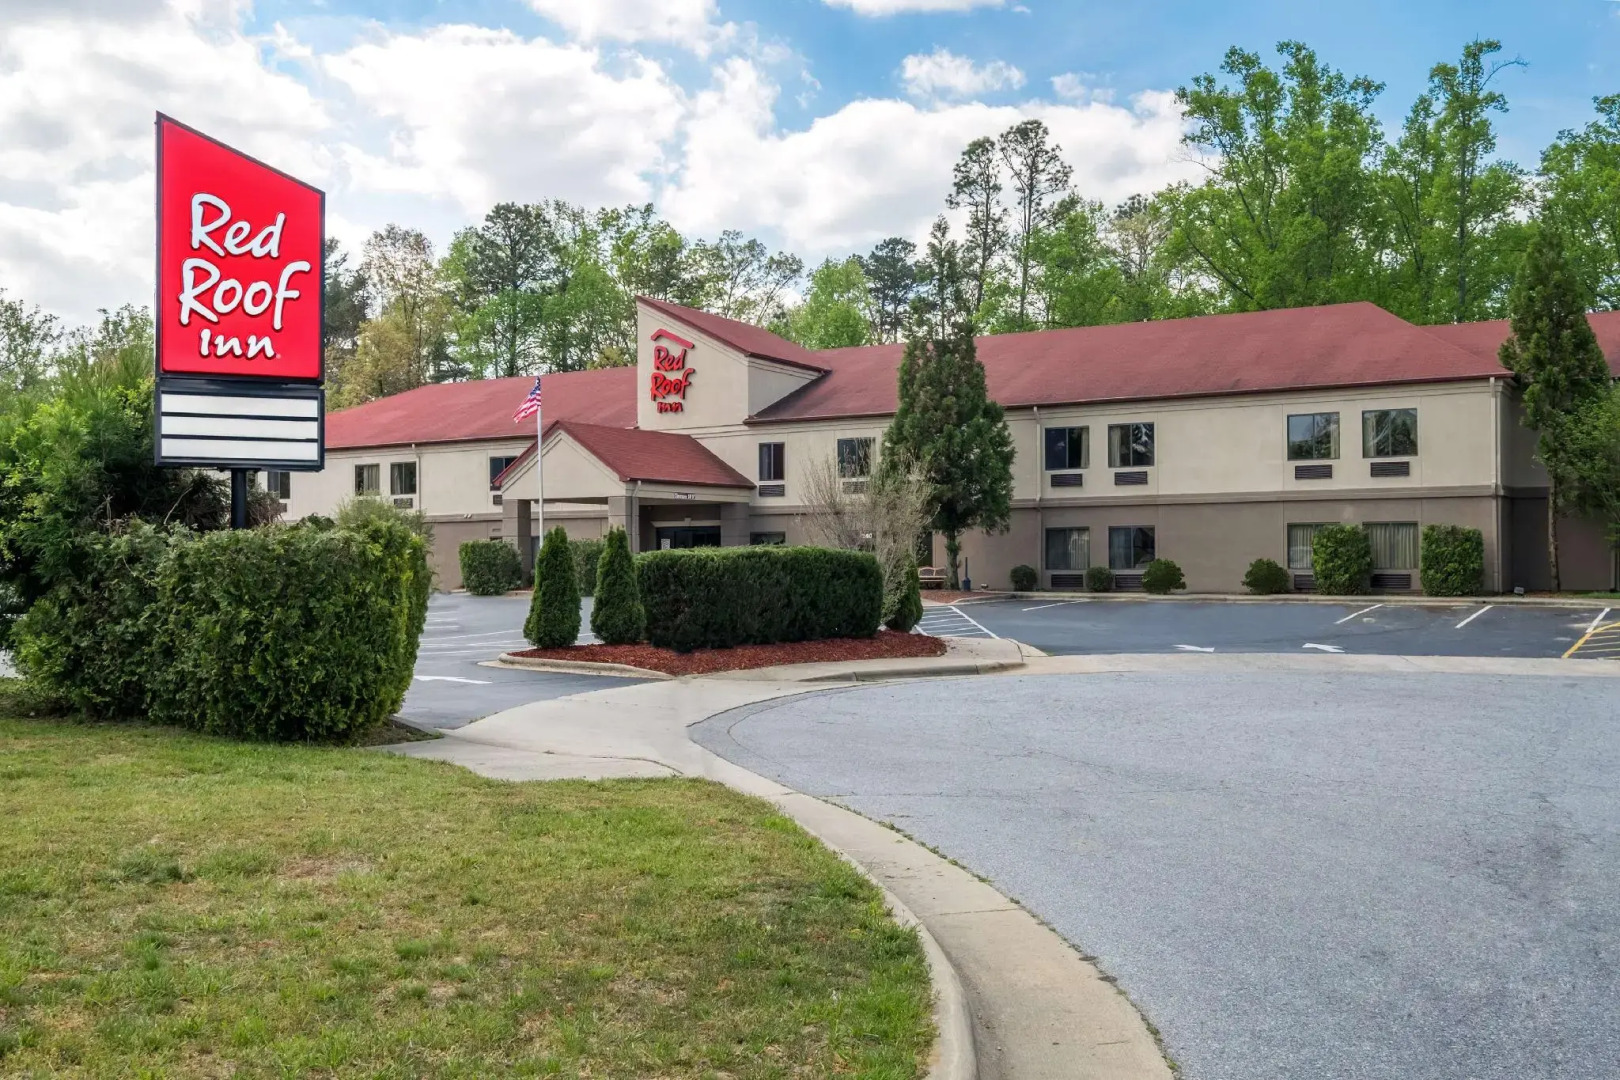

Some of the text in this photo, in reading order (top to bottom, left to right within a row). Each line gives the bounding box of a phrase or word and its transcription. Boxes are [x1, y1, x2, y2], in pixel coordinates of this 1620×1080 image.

[191, 192, 286, 258] Red
[178, 257, 311, 331] Roof
[653, 345, 687, 372] Red
[650, 367, 695, 402] Roof
